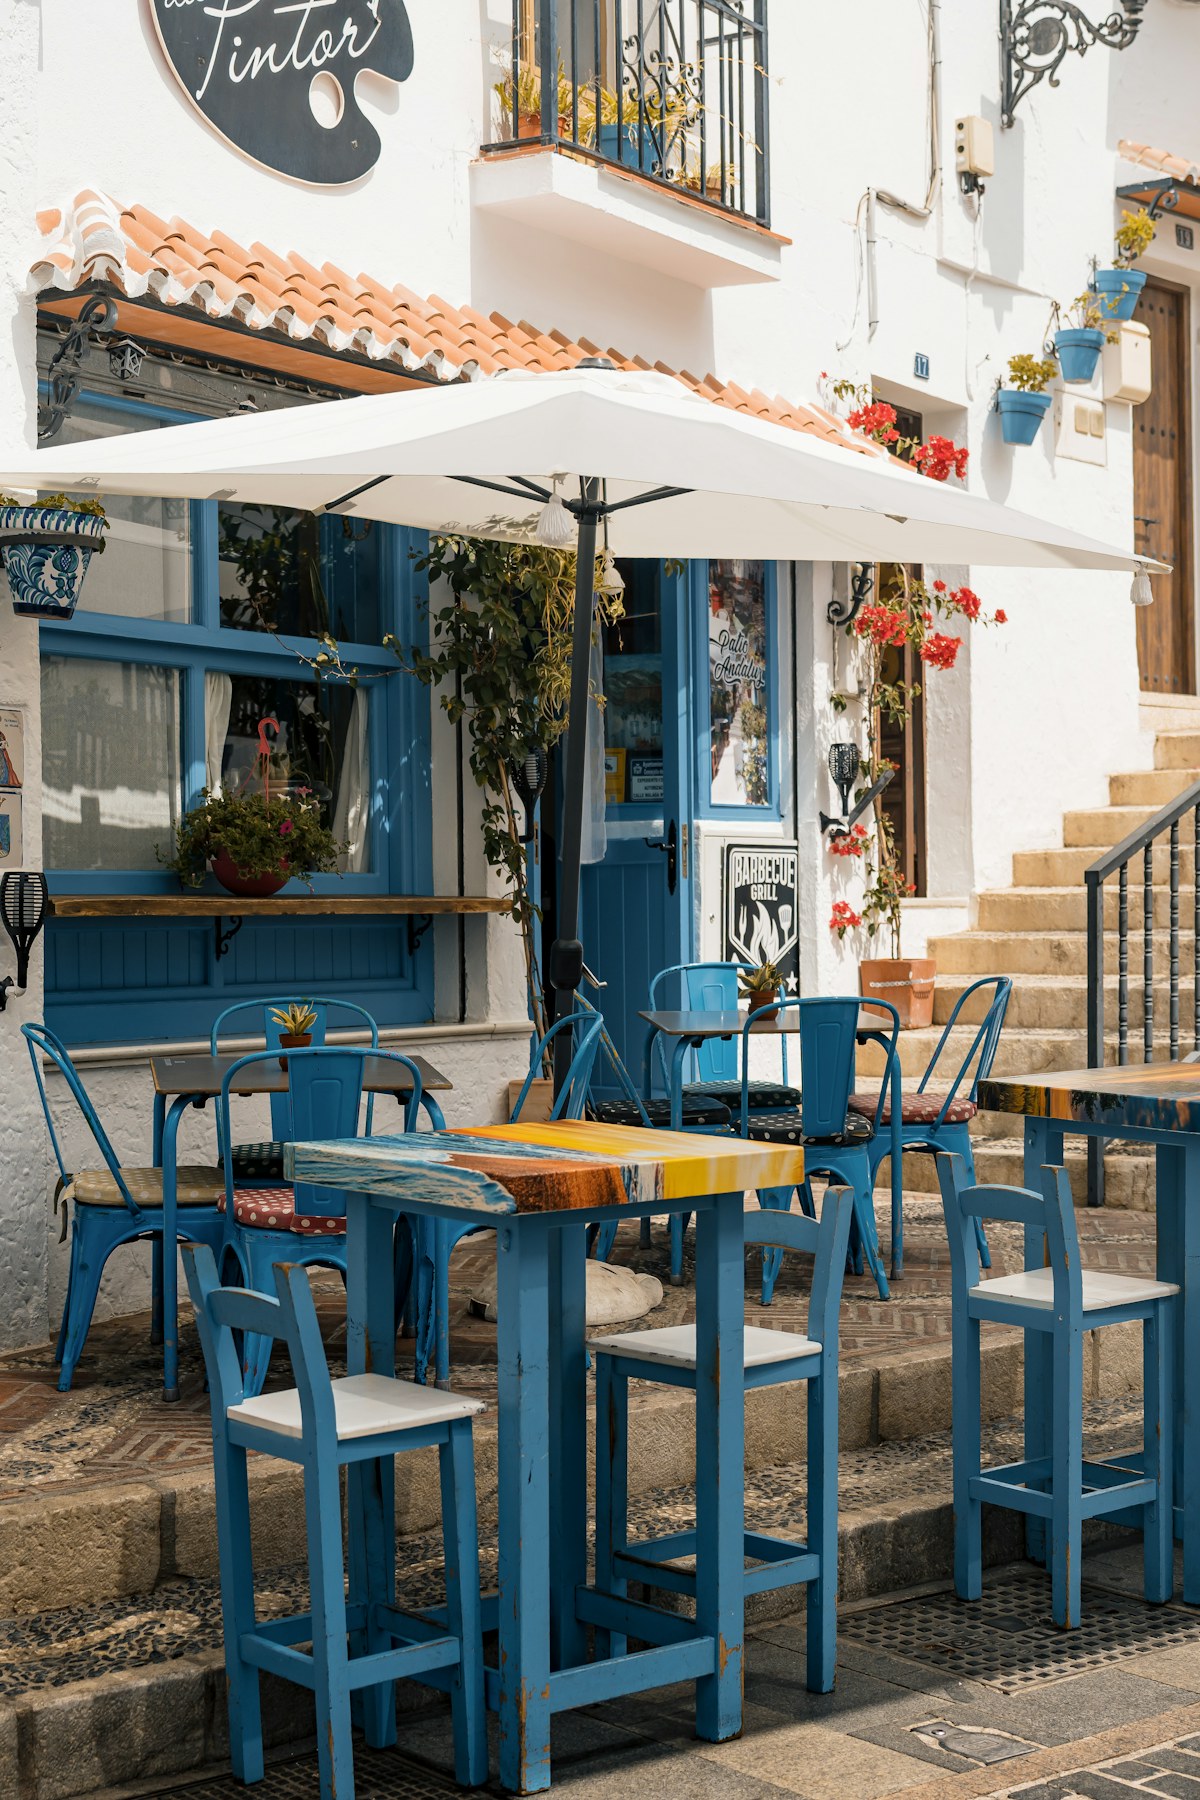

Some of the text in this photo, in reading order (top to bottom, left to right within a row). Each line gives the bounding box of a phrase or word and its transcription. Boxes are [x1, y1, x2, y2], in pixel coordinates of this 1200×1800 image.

[1180, 230, 1191, 247] 19
[917, 357, 927, 375] 17
[709, 629, 749, 655] Patio
[714, 656, 765, 688] Andaluz
[734, 856, 795, 889] BARBECUE
[750, 884, 778, 901] GRILL
